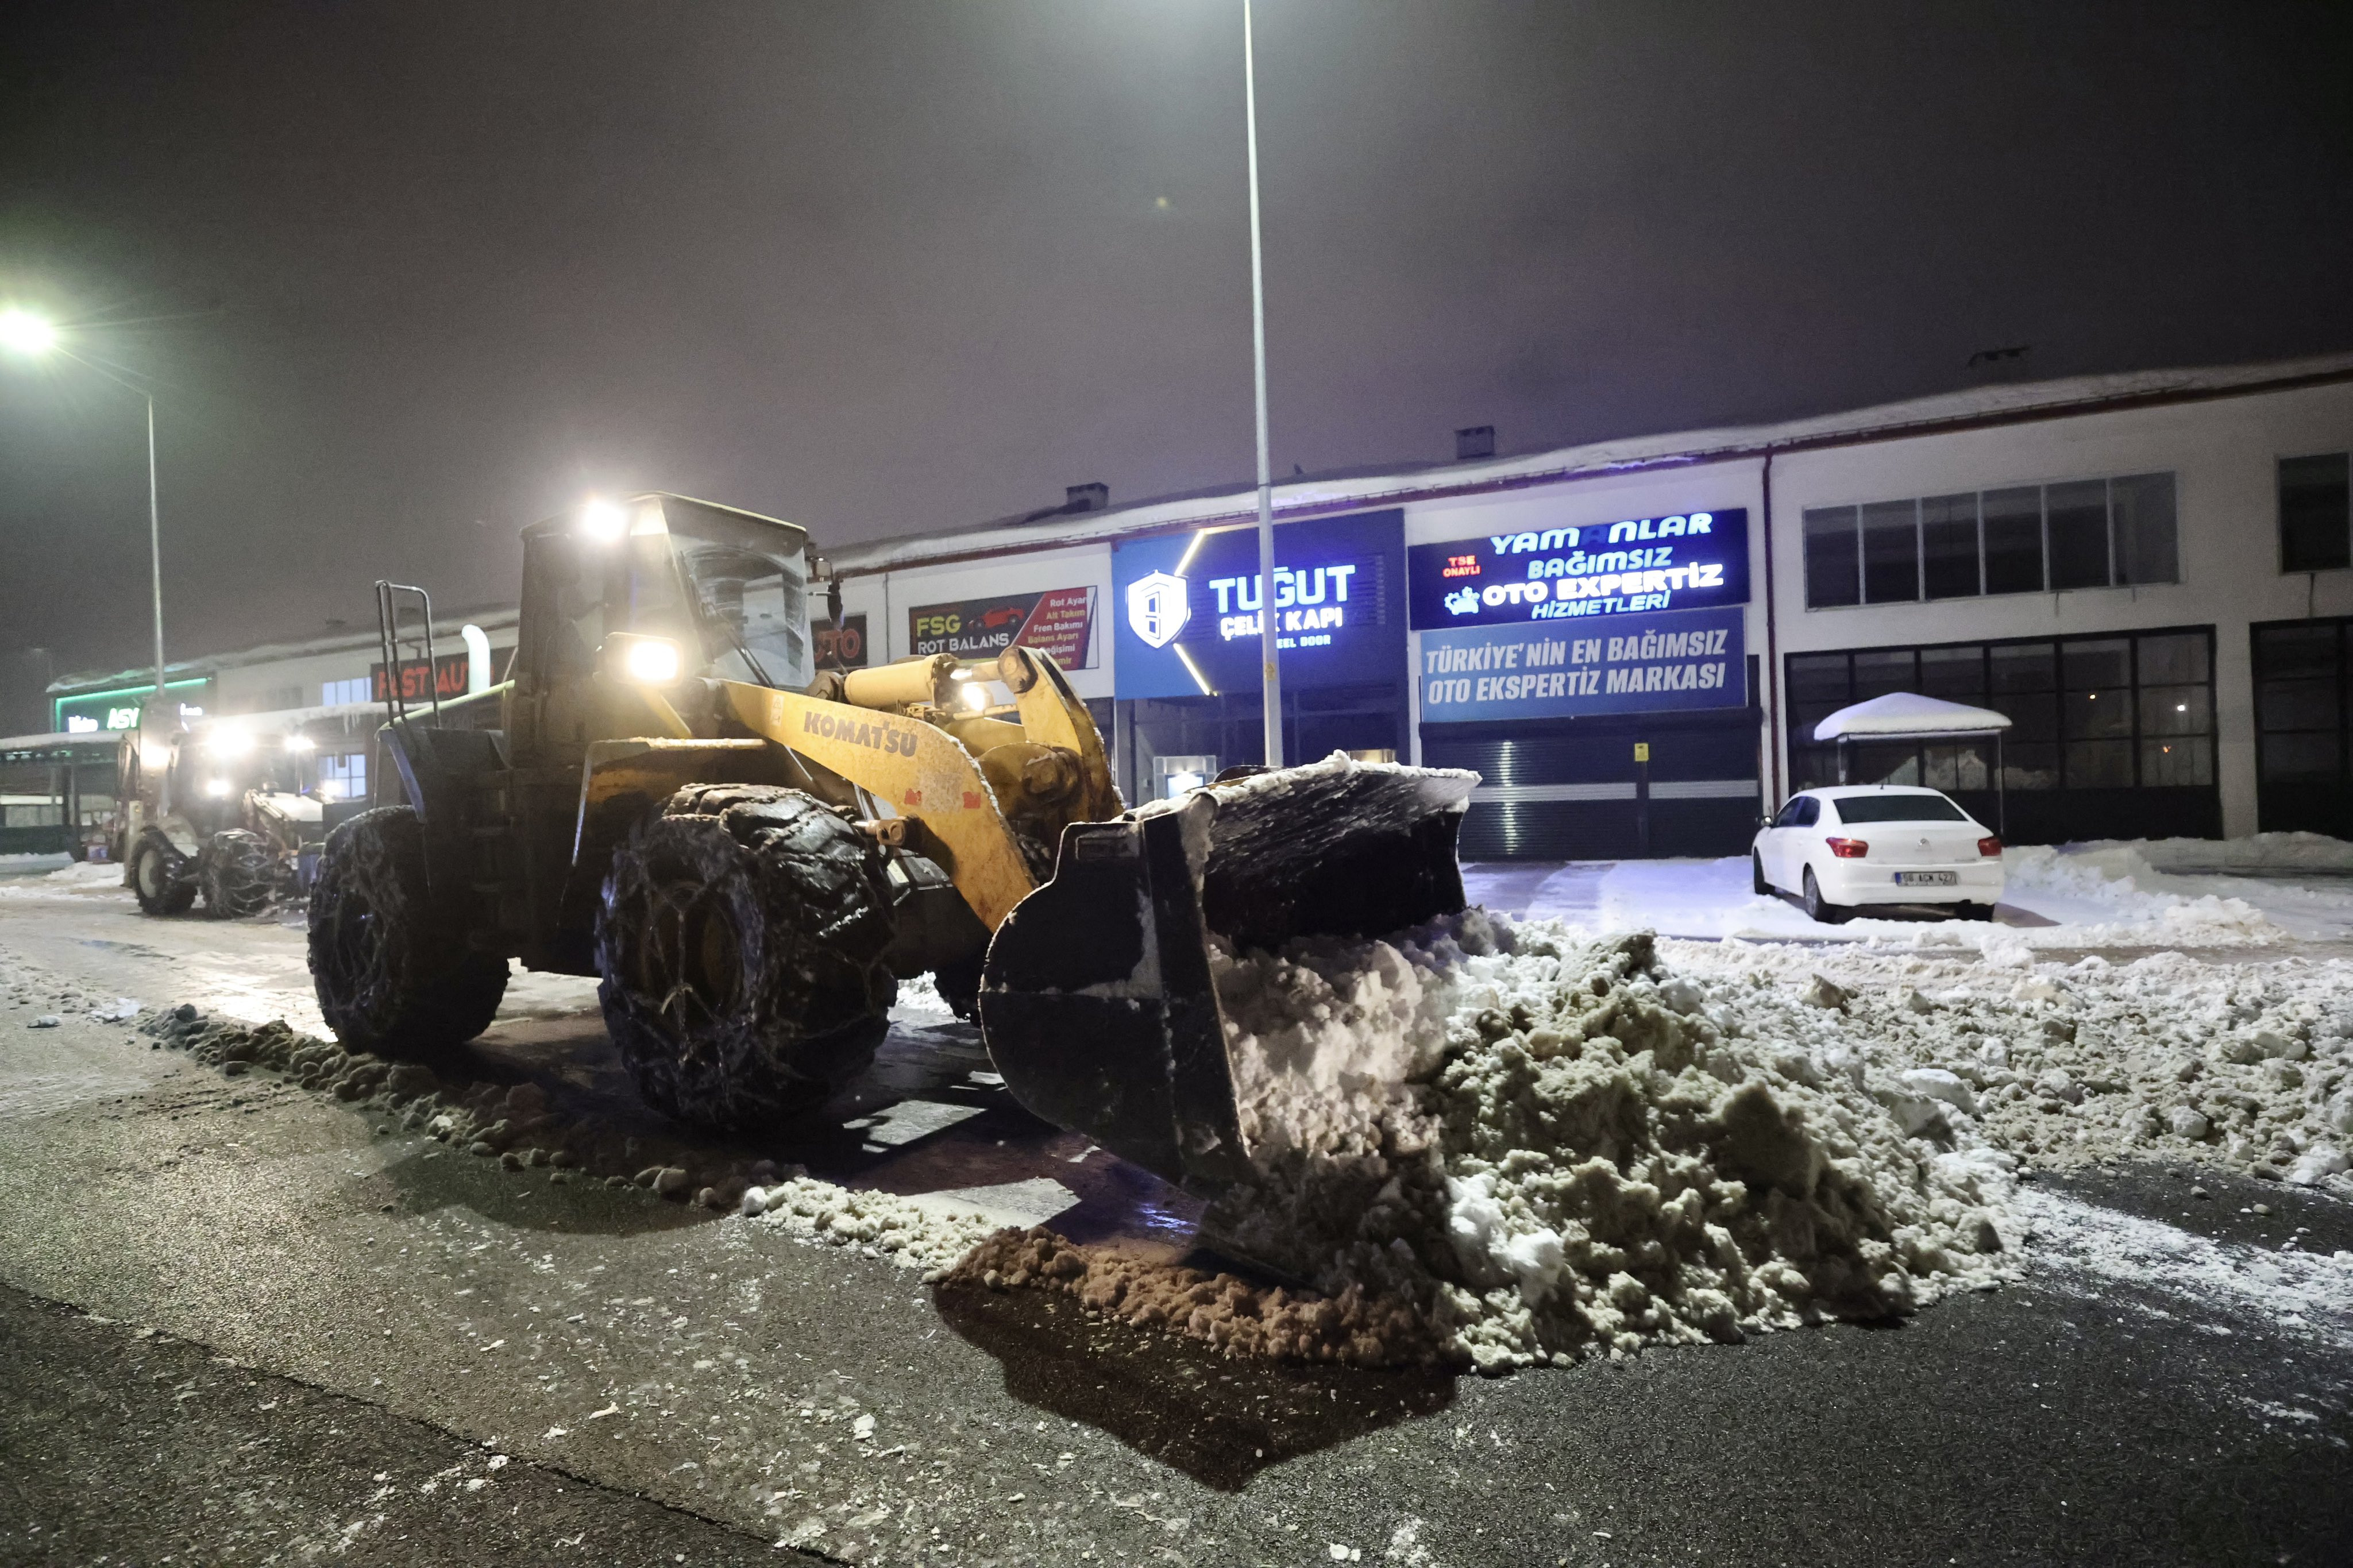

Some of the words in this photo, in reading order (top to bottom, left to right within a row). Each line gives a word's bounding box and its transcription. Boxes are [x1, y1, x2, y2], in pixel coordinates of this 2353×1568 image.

[1490, 513, 1712, 555] YAMANLAR
[1442, 565, 1481, 578] ONAYLI
[1447, 555, 1476, 567] TSE
[1527, 546, 1673, 579] BAĞIMSIZ
[1209, 565, 1355, 613] TUĞUT
[1482, 581, 1548, 606] OTO
[1557, 562, 1724, 600] EXPERTİZ
[1050, 598, 1064, 607] Rot
[1531, 589, 1672, 619] HİZMETLERİ
[916, 614, 962, 637] FSG
[1034, 624, 1052, 632] Fren
[1054, 621, 1083, 631] Bakımı
[1286, 607, 1343, 631] KAPI
[917, 639, 945, 654] ROT
[949, 633, 1009, 651] BALANS
[1028, 635, 1055, 644] Balans
[1044, 643, 1076, 655] eğişimi
[1300, 635, 1331, 646] DOOR
[1426, 638, 1565, 674] TÜRKİYE'NİN
[1571, 639, 1602, 663] EN
[1607, 629, 1729, 662] BAĞIMSIZ
[1428, 678, 1471, 704] OTO
[1476, 666, 1602, 701] EKSPERTİZ
[1606, 662, 1726, 694] MARKASI
[804, 711, 918, 758] KOMATSU
